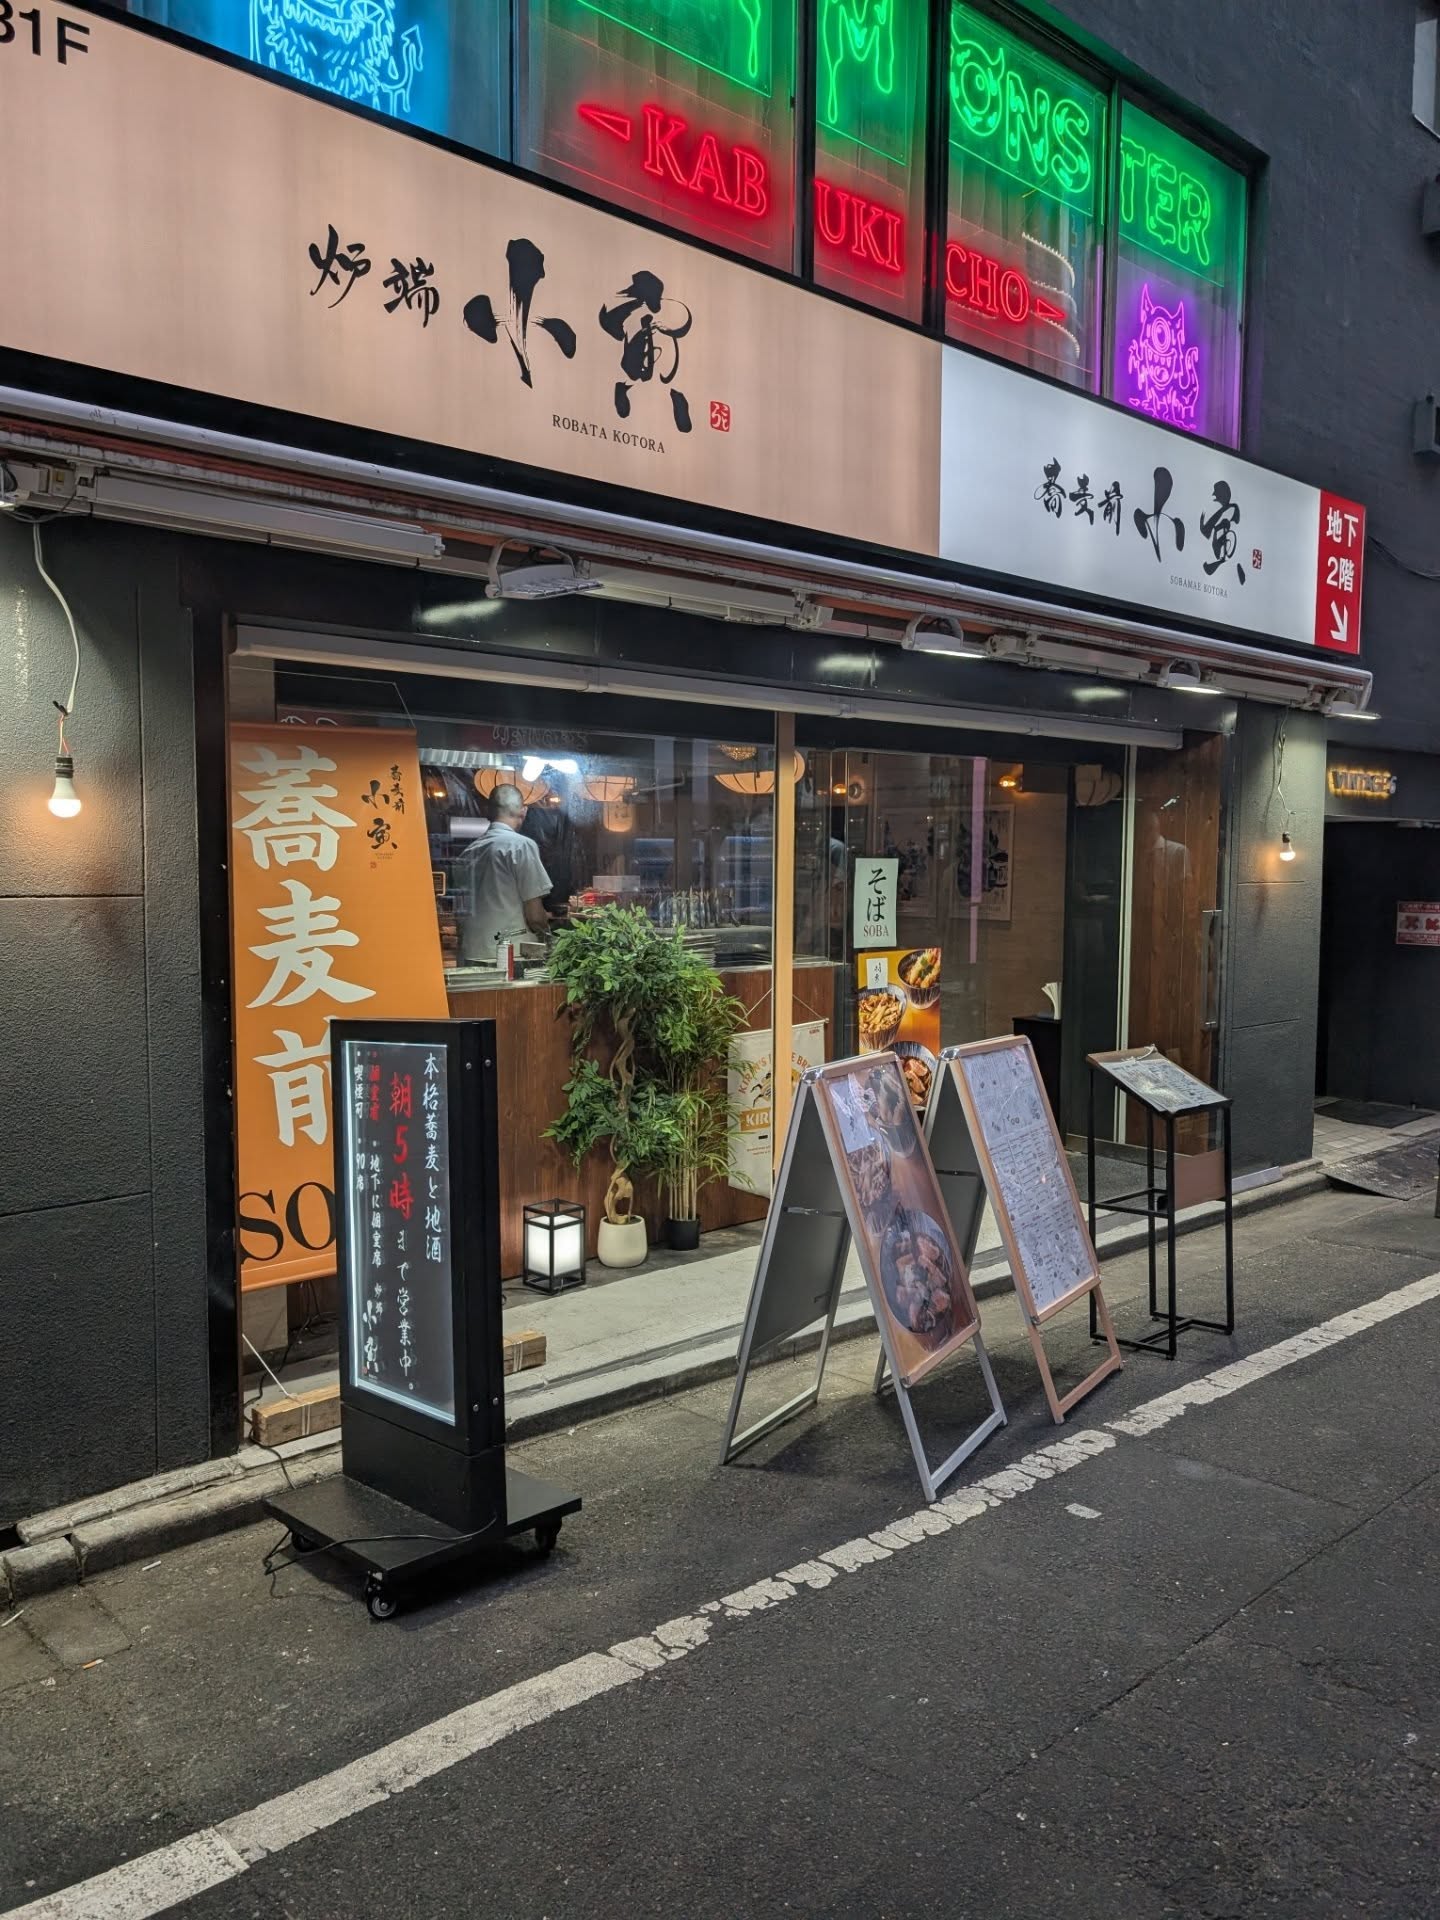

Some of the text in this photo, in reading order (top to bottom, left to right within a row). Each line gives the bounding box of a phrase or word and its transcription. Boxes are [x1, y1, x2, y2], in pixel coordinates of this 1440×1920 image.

[552, 414, 665, 454] ROBATA KOTORA
[1326, 506, 1359, 548] 地下
[1326, 556, 1355, 593] 2階
[866, 867, 888, 922] そば
[863, 924, 890, 937] SOBA
[423, 1052, 443, 1264] 本格蕎麦と地酒
